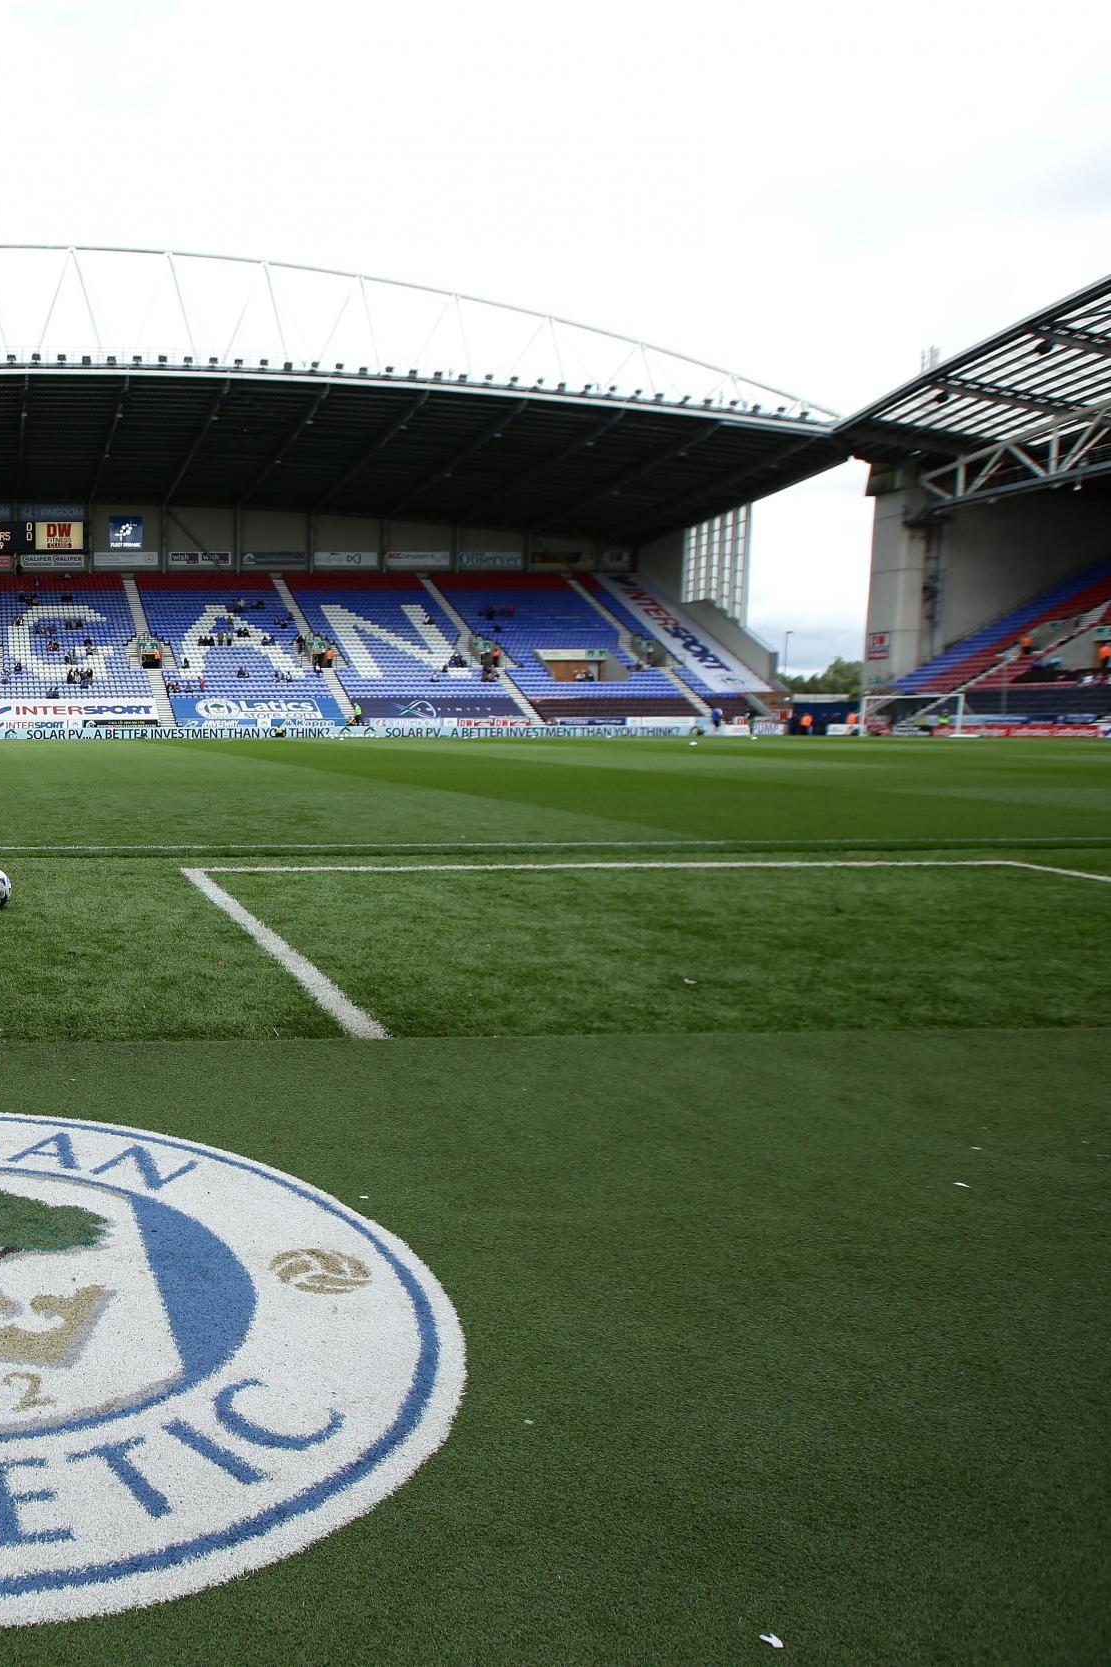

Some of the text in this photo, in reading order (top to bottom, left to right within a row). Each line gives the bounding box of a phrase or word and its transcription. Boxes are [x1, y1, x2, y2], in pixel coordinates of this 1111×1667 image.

[47, 524, 71, 538] DW
[622, 586, 732, 673] INTERSPORT
[15, 705, 153, 716] INTERSPORT
[239, 700, 314, 712] Latics
[5, 721, 65, 729] INTERSPORT
[296, 719, 336, 727] Kappa
[392, 719, 440, 727] KINGDOM
[27, 730, 67, 741] SOLAR
[94, 729, 103, 740] A
[105, 729, 148, 740] BETTER
[151, 728, 225, 739] INVESTMENT
[227, 727, 260, 738] THAN
[291, 727, 330, 738] THINK?
[385, 728, 426, 738] SOLAR
[451, 727, 460, 737] A
[462, 727, 505, 737] BETTER
[507, 727, 577, 737] INVESTMENT
[580, 727, 613, 737] THAN
[615, 727, 638, 737] YOU
[640, 727, 681, 737] THINK?
